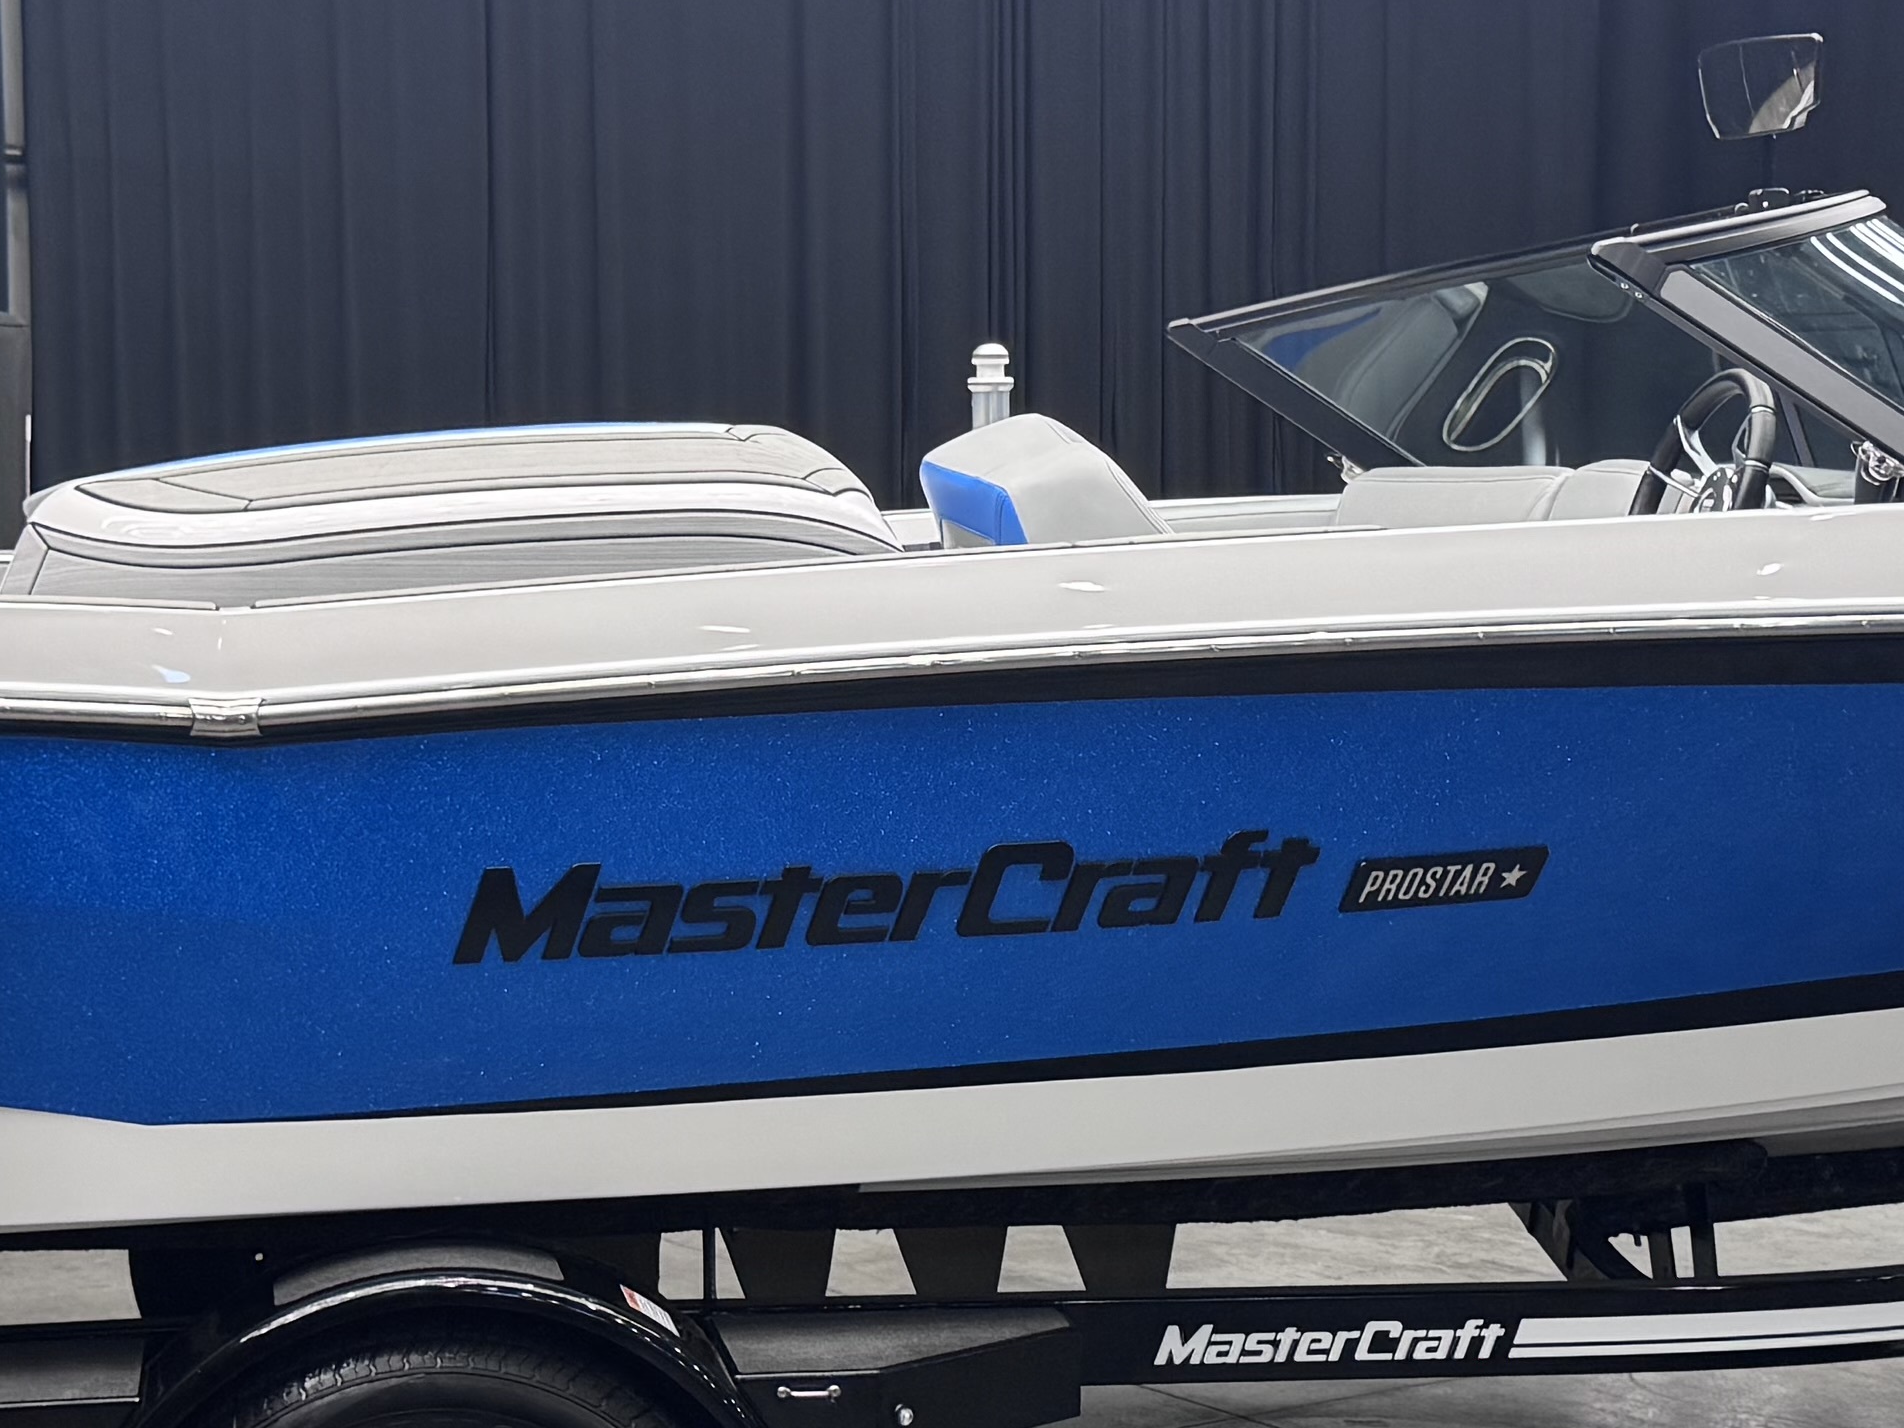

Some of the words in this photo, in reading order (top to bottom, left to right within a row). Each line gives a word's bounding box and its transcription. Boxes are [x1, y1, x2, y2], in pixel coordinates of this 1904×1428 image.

[452, 829, 1320, 965] MasterCraft
[1358, 862, 1495, 903] PROSTAR
[1154, 1319, 1505, 1366] MasterCraft
